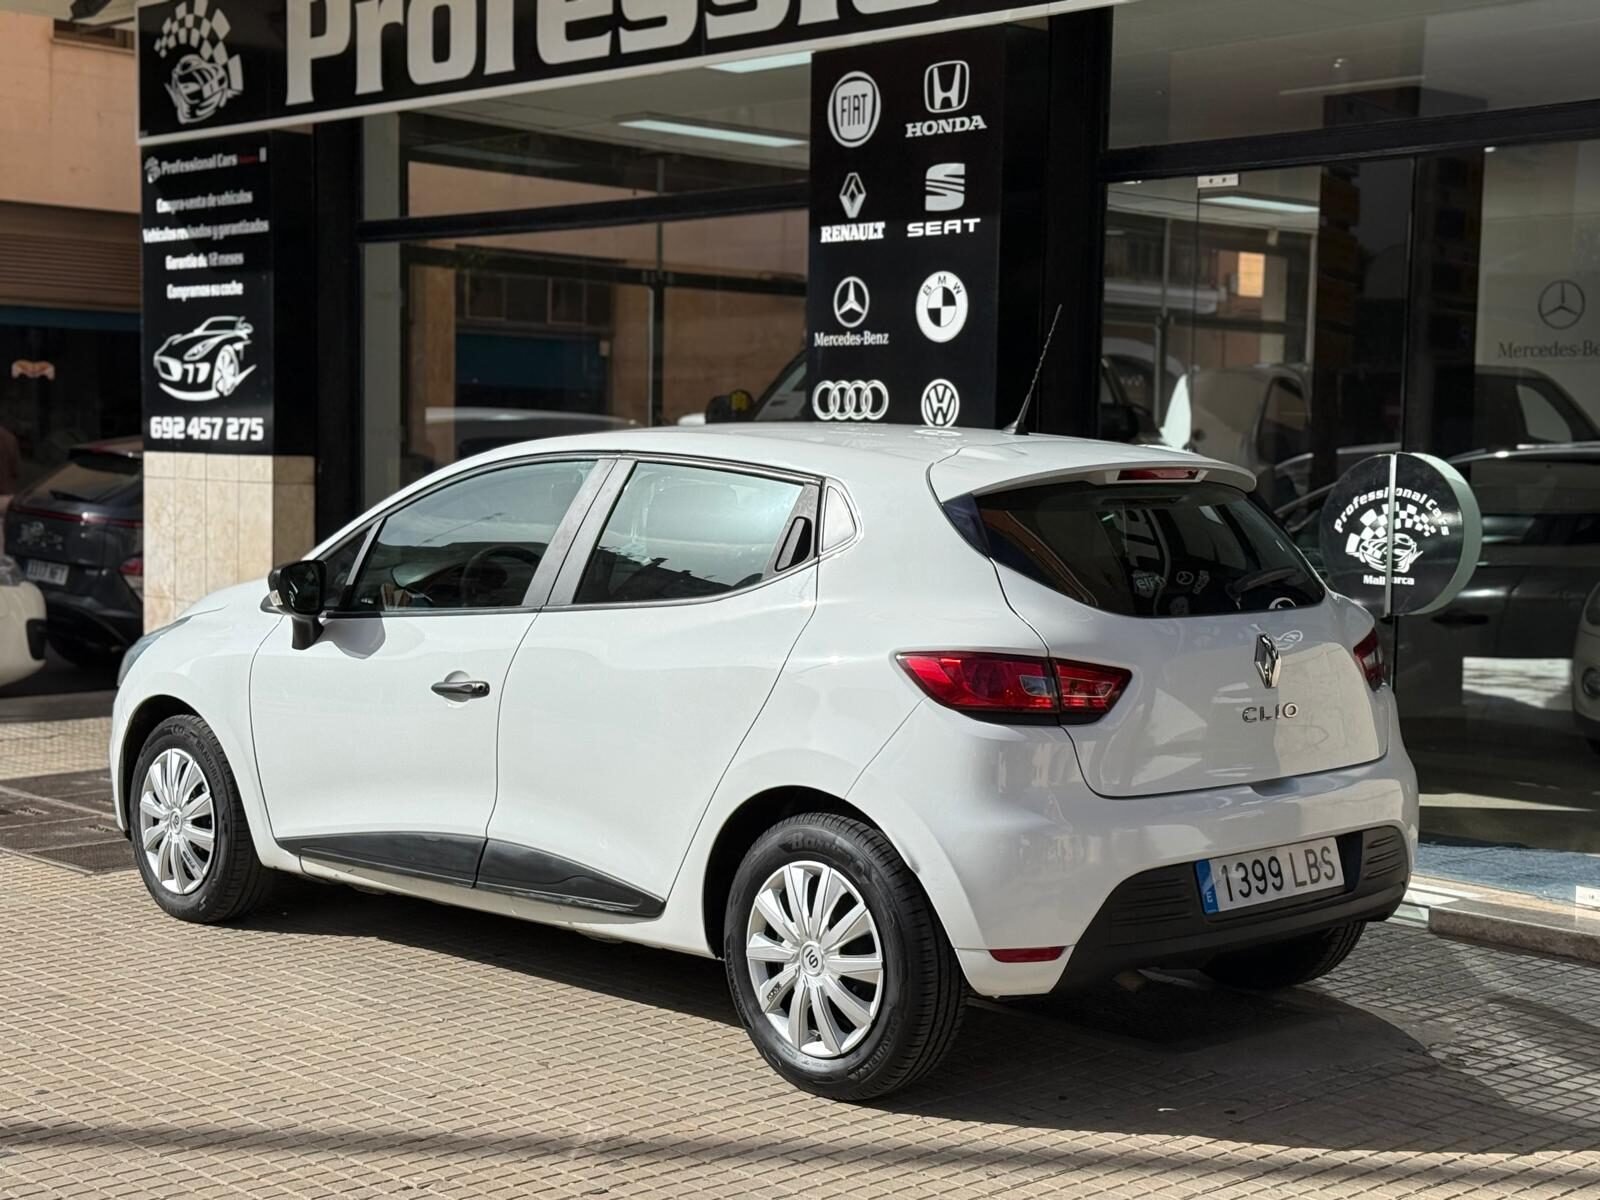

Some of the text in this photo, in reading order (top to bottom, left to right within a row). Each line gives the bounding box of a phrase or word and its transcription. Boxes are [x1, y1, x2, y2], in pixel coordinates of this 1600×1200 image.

[840, 93, 869, 128] FIAT
[905, 114, 987, 138] HONDA
[160, 153, 217, 175] Professional
[820, 221, 886, 243] RENAULT
[906, 217, 982, 238] SEAT
[813, 330, 889, 347] Mercedes-Benz
[150, 415, 264, 441] 692 457 275
[1242, 701, 1298, 723] CLIO
[1220, 845, 1336, 903] 1399 LBS
